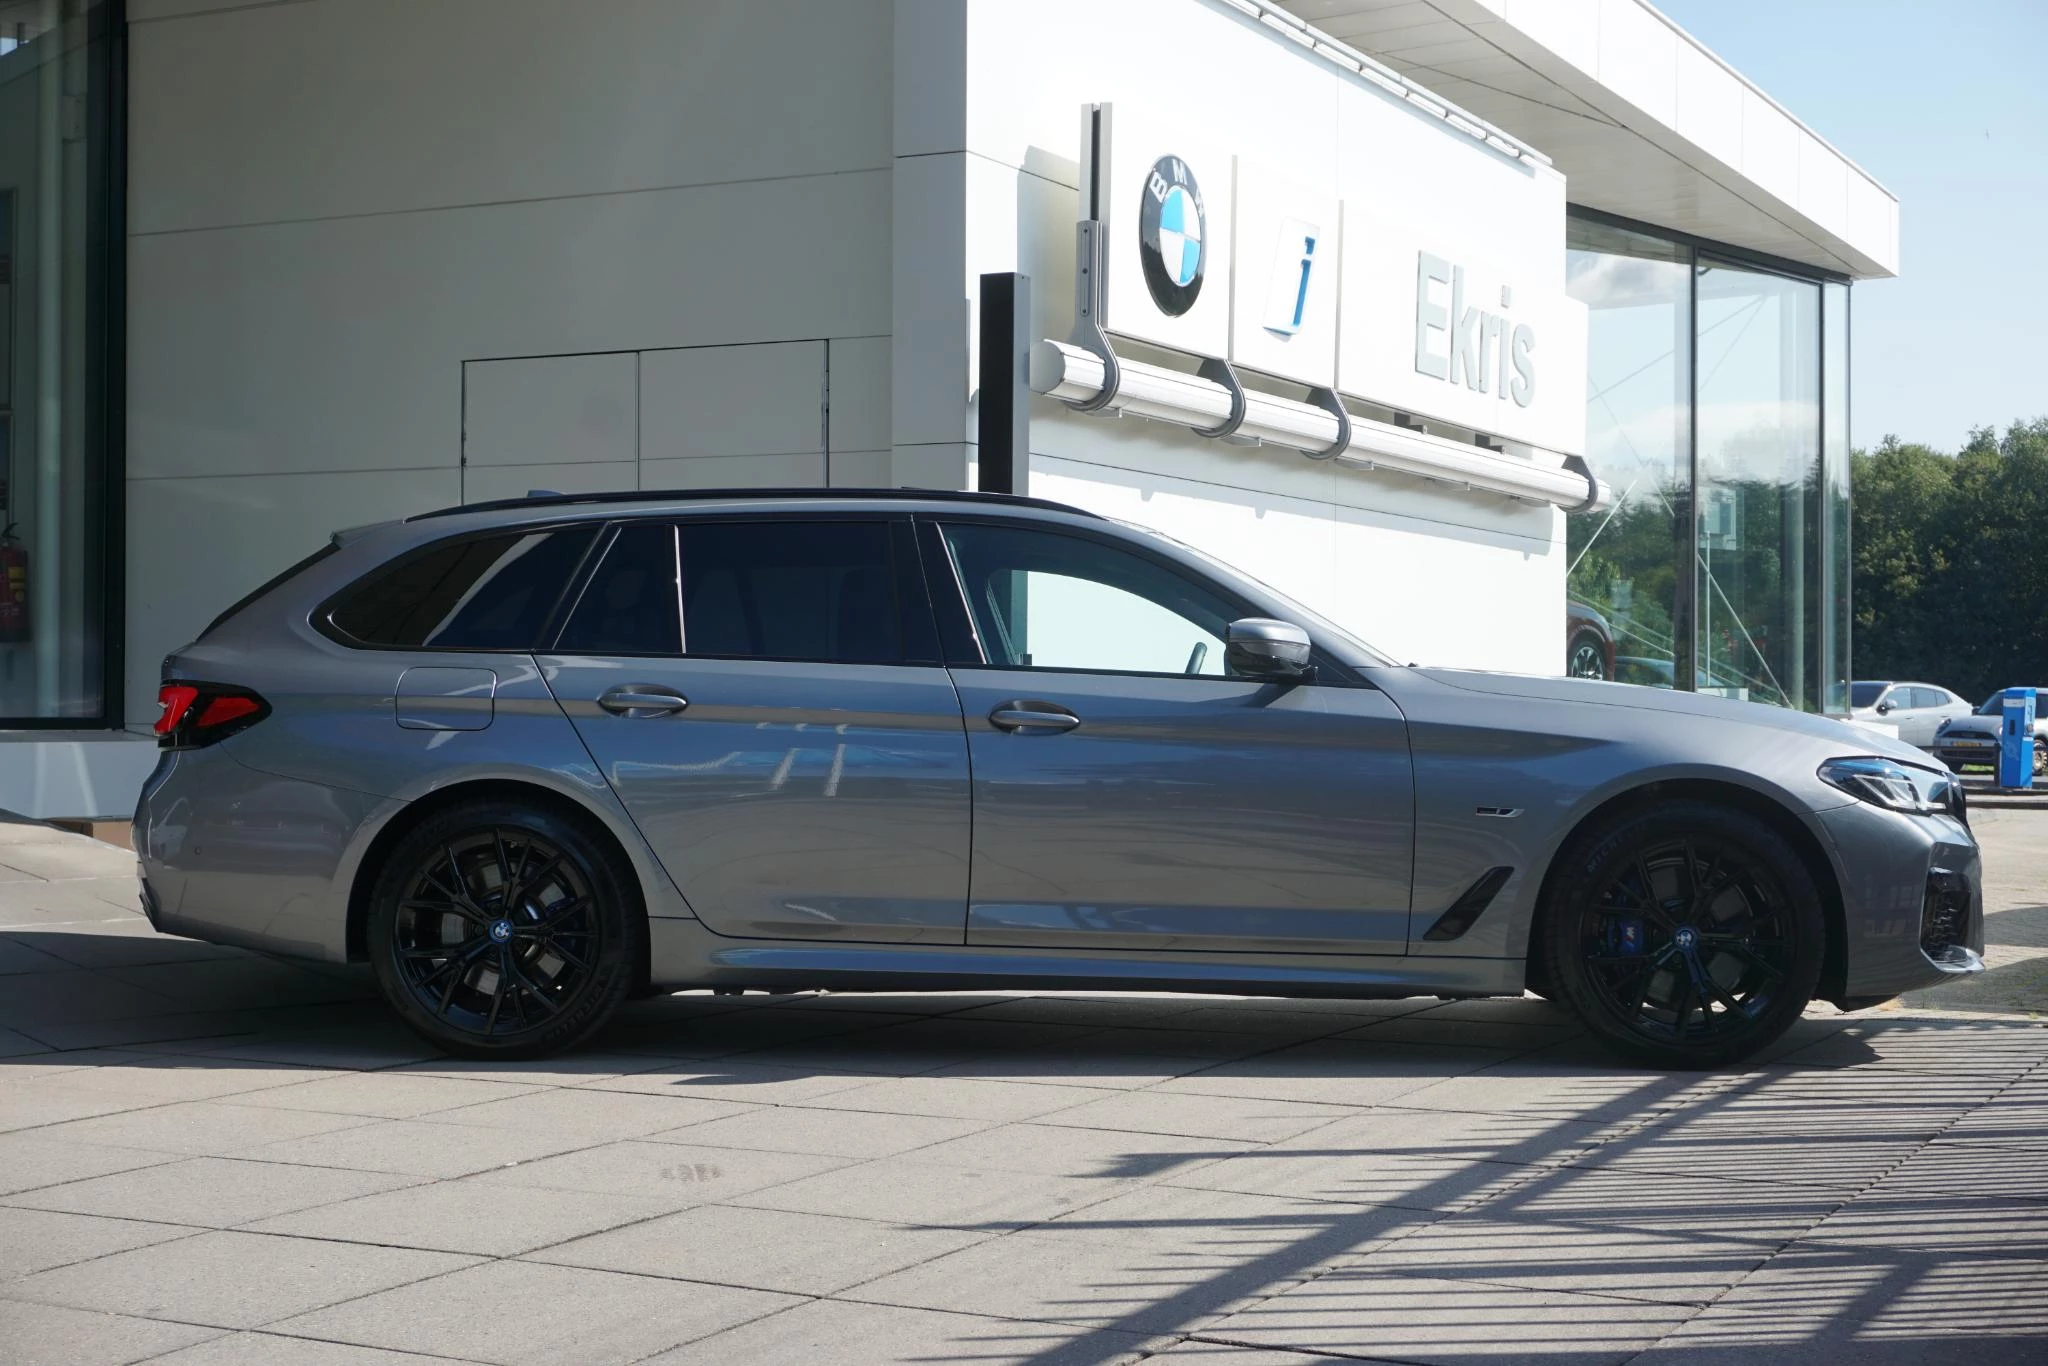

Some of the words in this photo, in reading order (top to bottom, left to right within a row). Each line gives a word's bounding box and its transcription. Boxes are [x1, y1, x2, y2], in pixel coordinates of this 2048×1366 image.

[1149, 158, 1205, 217] BMW
[1293, 236, 1316, 326] i
[1415, 250, 1535, 408] Ekris
